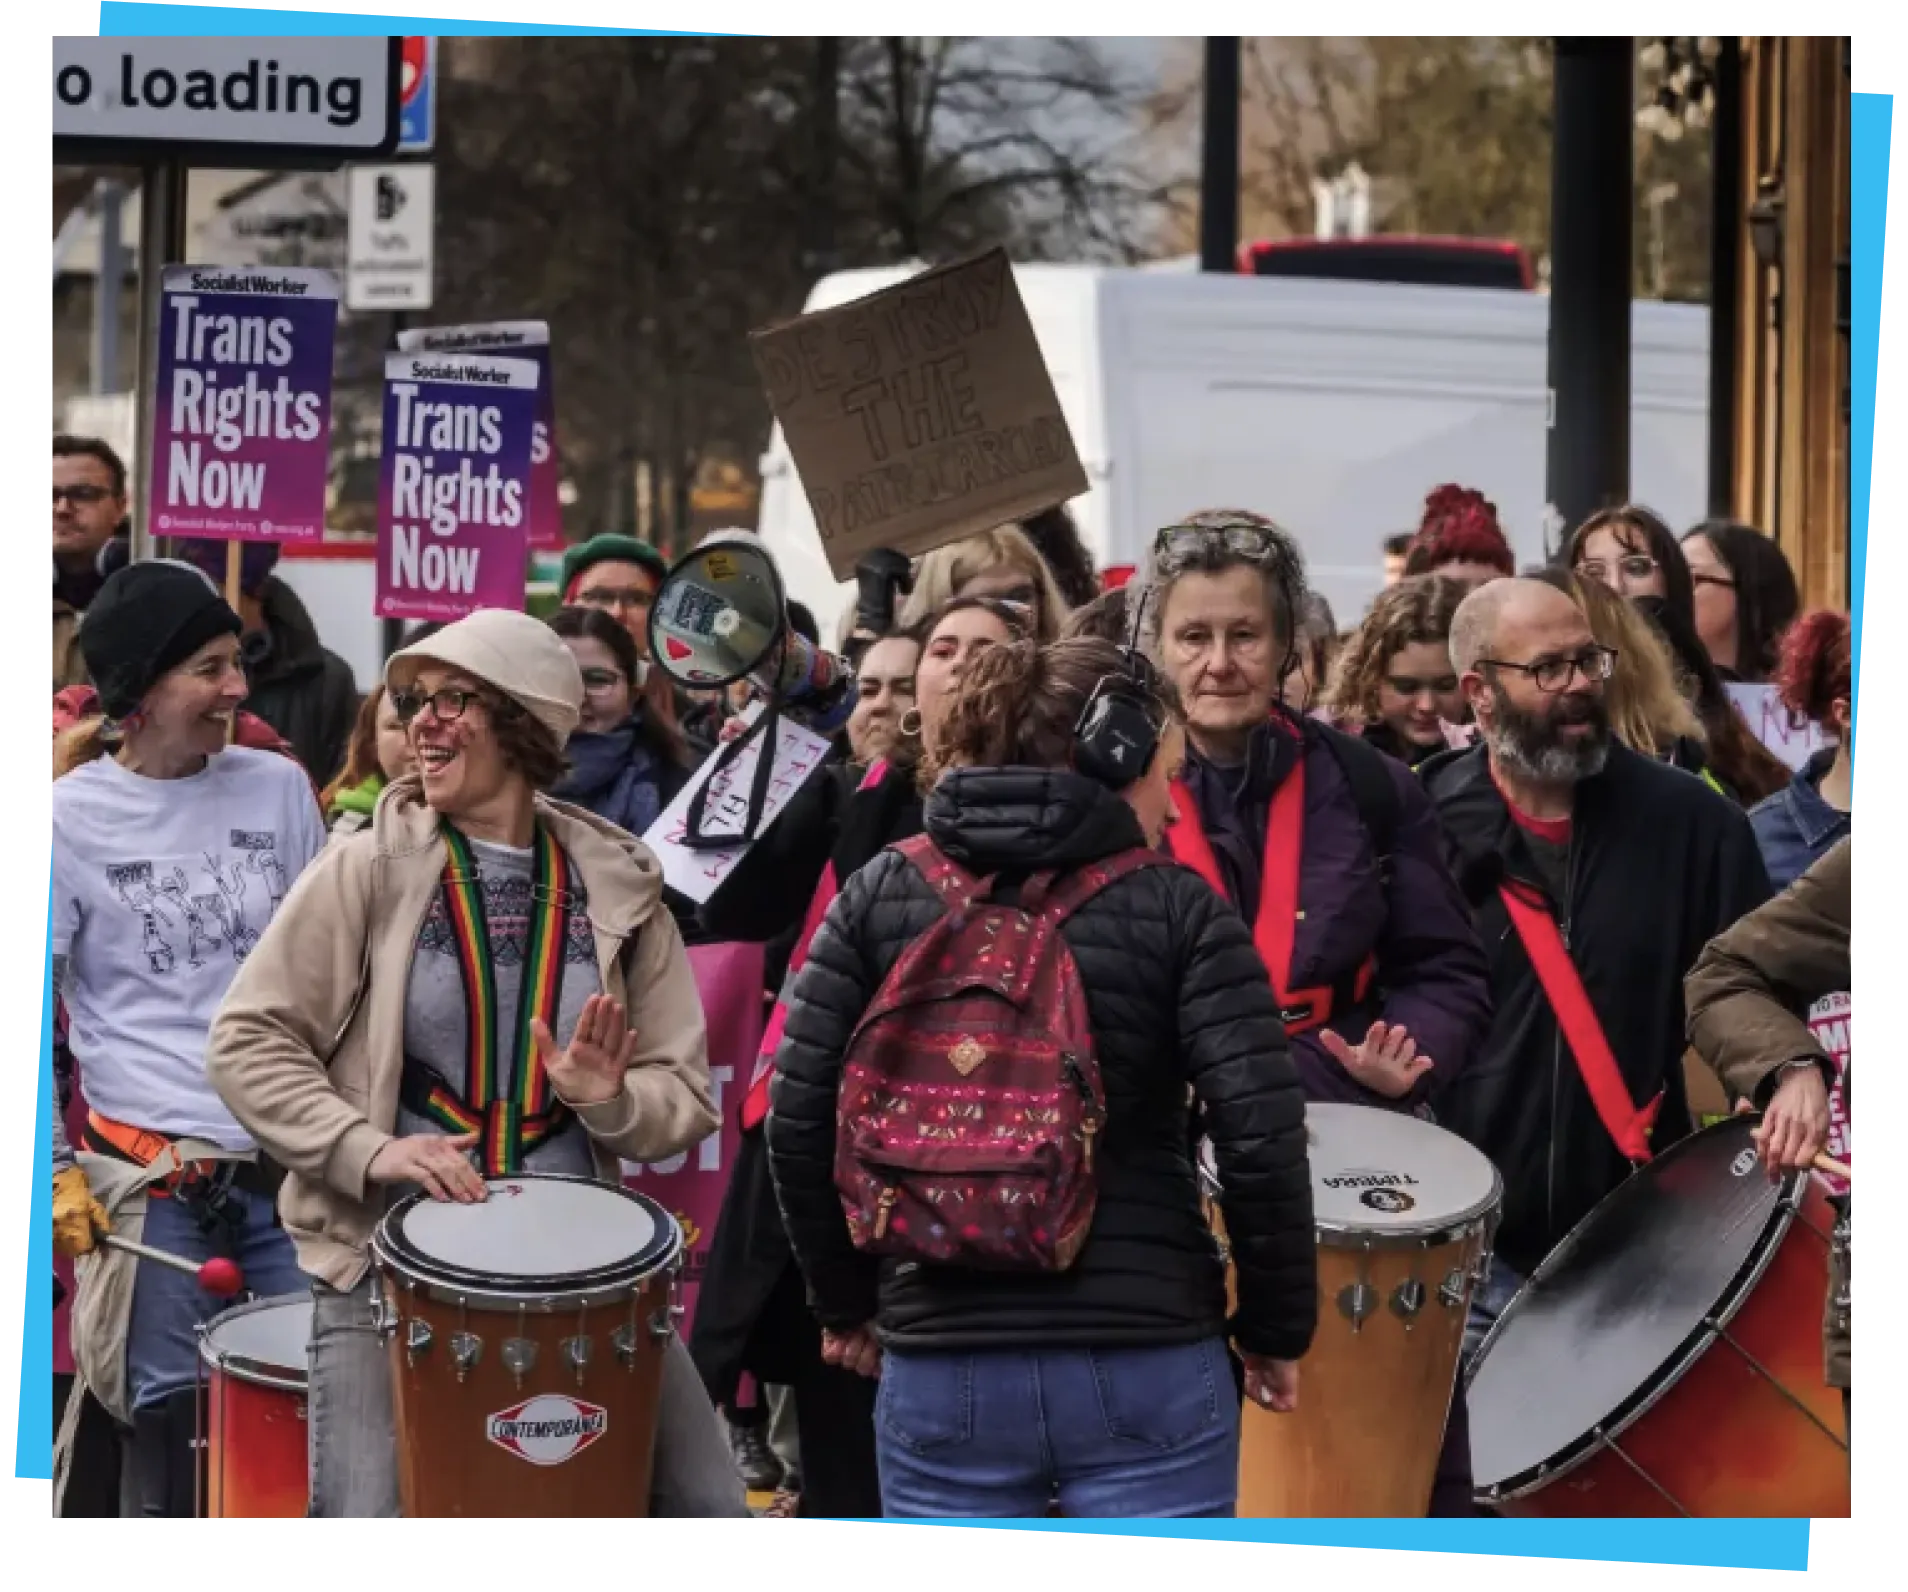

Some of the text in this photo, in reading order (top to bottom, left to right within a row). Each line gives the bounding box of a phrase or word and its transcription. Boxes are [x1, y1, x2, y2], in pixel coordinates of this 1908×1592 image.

[120, 53, 362, 127] loading
[191, 273, 308, 295] Socialist Worker
[170, 296, 294, 367] Trans
[757, 262, 1002, 408] DESTROY
[171, 368, 321, 451] Rights
[464, 364, 510, 385] Worker
[840, 350, 985, 463] THE
[391, 383, 503, 454] Trans
[168, 441, 266, 510] Now
[392, 453, 523, 536] Rights
[391, 525, 481, 594] Now
